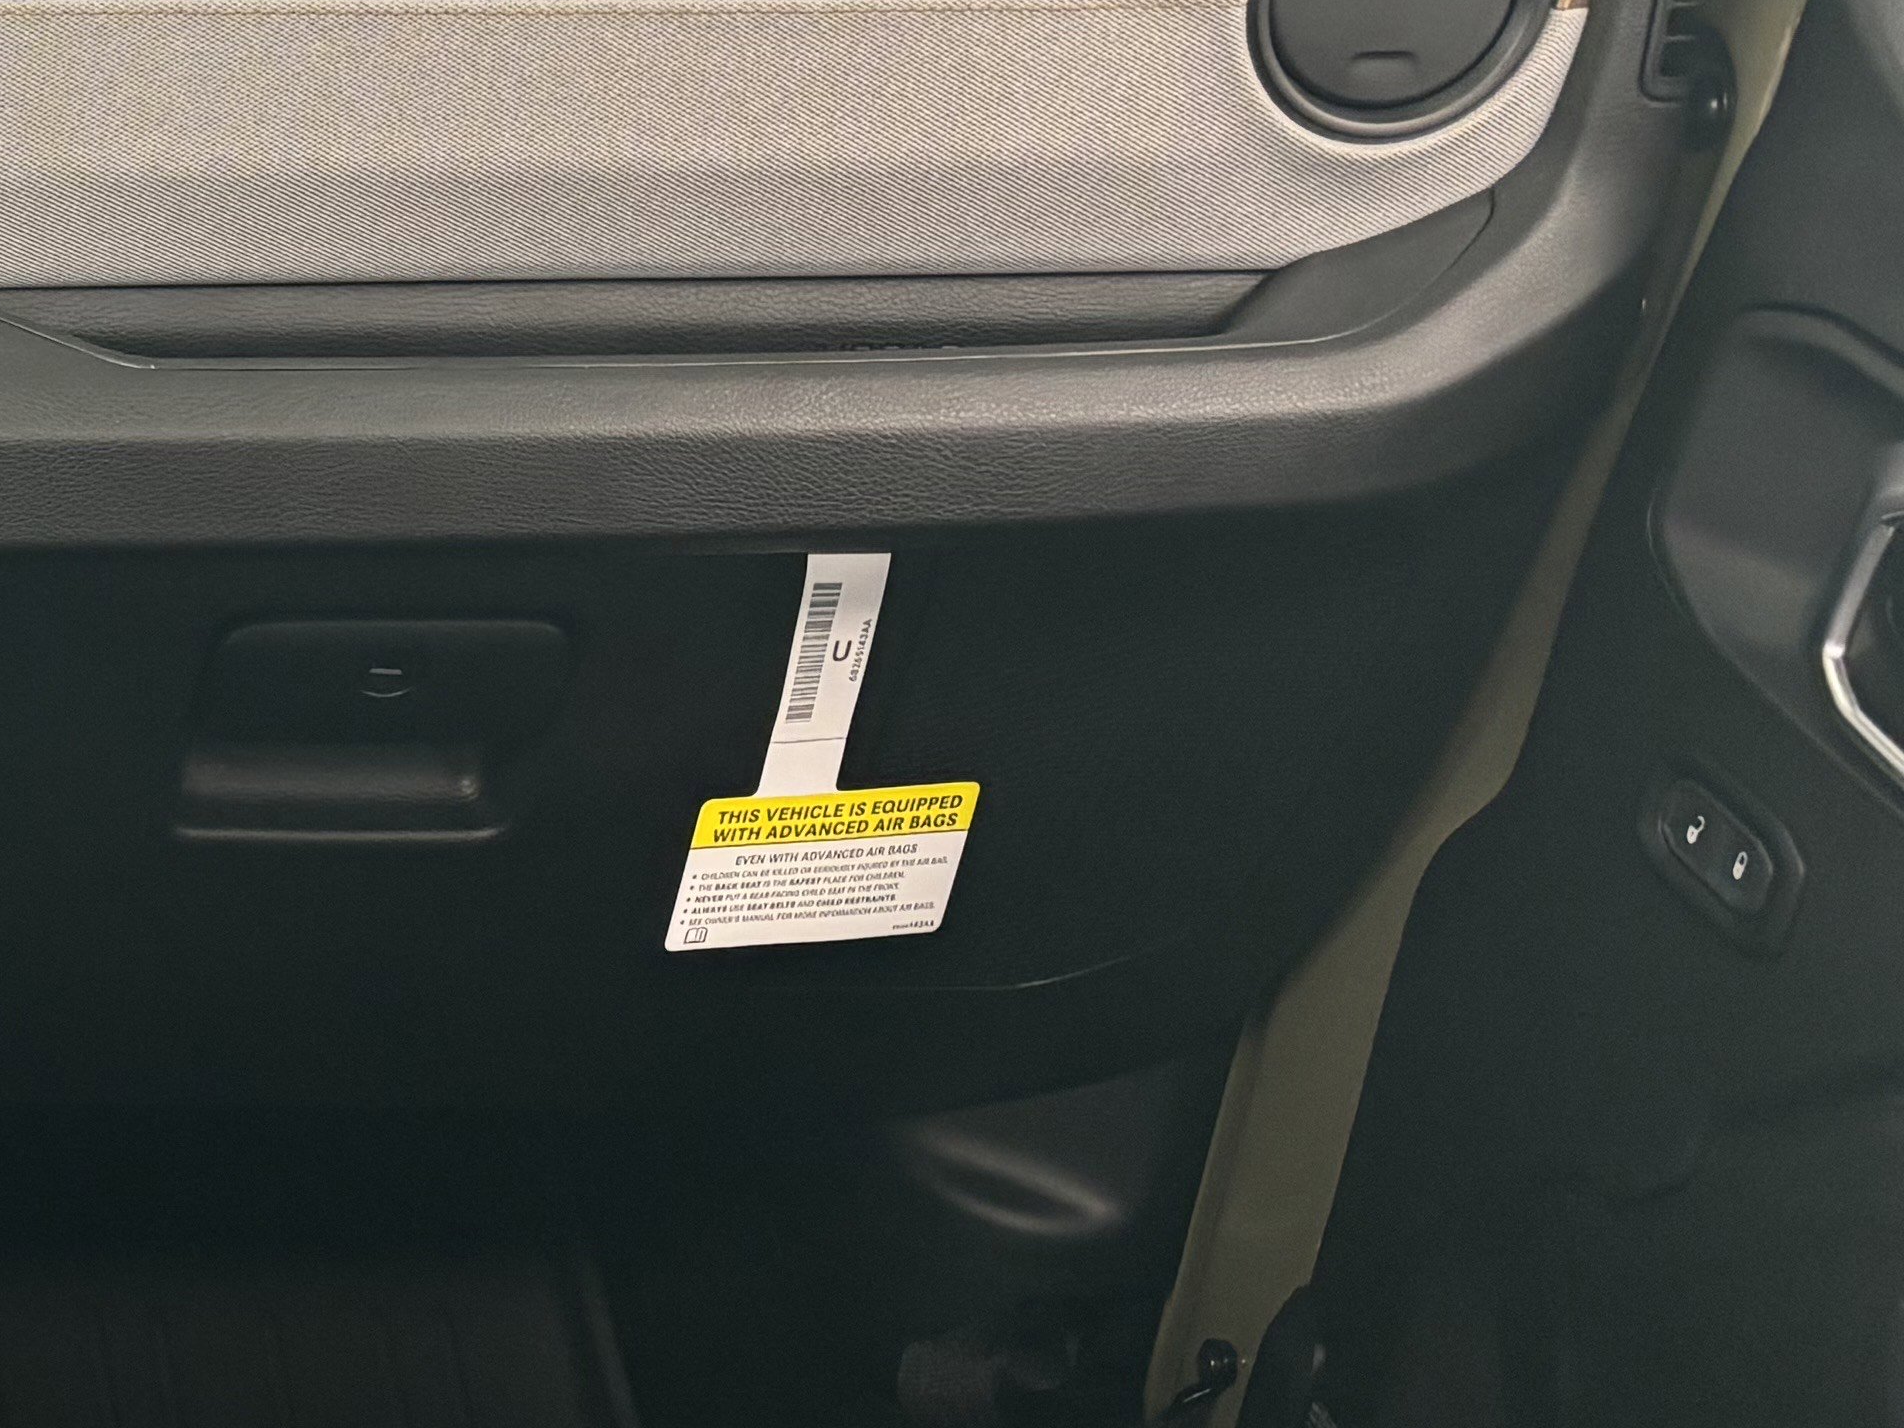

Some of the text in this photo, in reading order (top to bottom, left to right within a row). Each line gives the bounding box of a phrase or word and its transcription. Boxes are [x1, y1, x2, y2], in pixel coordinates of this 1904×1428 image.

[832, 639, 854, 663] U
[718, 794, 964, 826] THIS VEHICLE IS EQUIPPED
[713, 812, 959, 844] WITH ADVANCED AIR BAGS
[735, 843, 919, 867] EVEN WITH ADVANCED AIR BAGS
